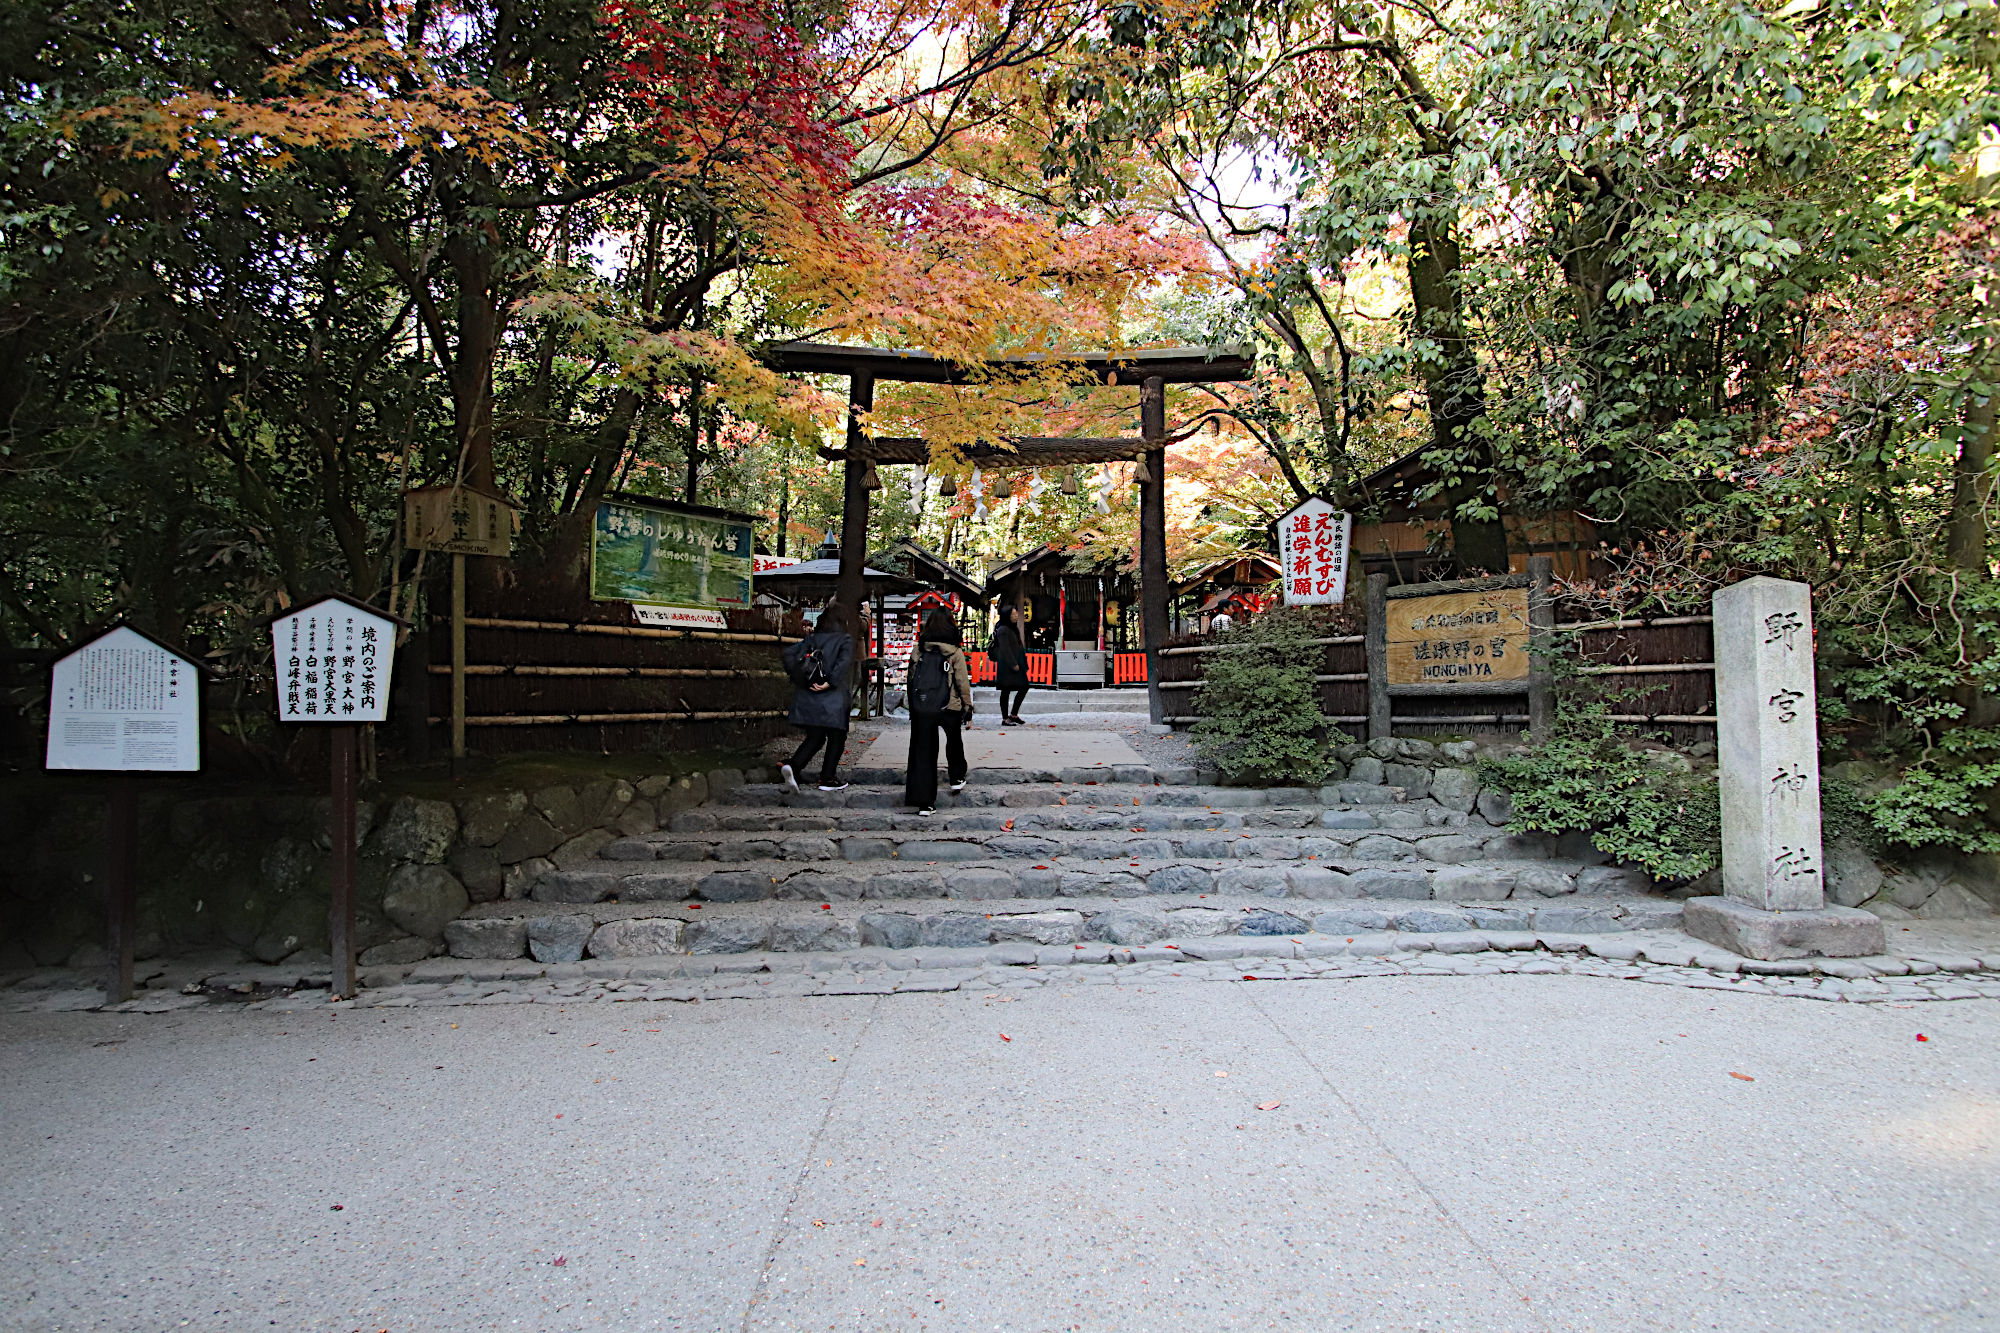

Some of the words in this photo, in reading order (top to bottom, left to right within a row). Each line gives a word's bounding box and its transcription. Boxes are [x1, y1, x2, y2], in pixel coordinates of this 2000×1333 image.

[448, 543, 489, 553] SMOKING
[1293, 514, 1312, 595] 進学祈願
[1315, 513, 1336, 595] えんむすび
[287, 655, 301, 714] 白峰弁財天
[305, 655, 318, 715] 白福稲荷
[323, 655, 336, 715] 野宮大黒天
[342, 655, 355, 715] 野宮大神
[361, 626, 377, 710] 境内のご案内
[1423, 663, 1492, 678] NONOMIYA
[1764, 611, 1817, 881] 野宮神社
